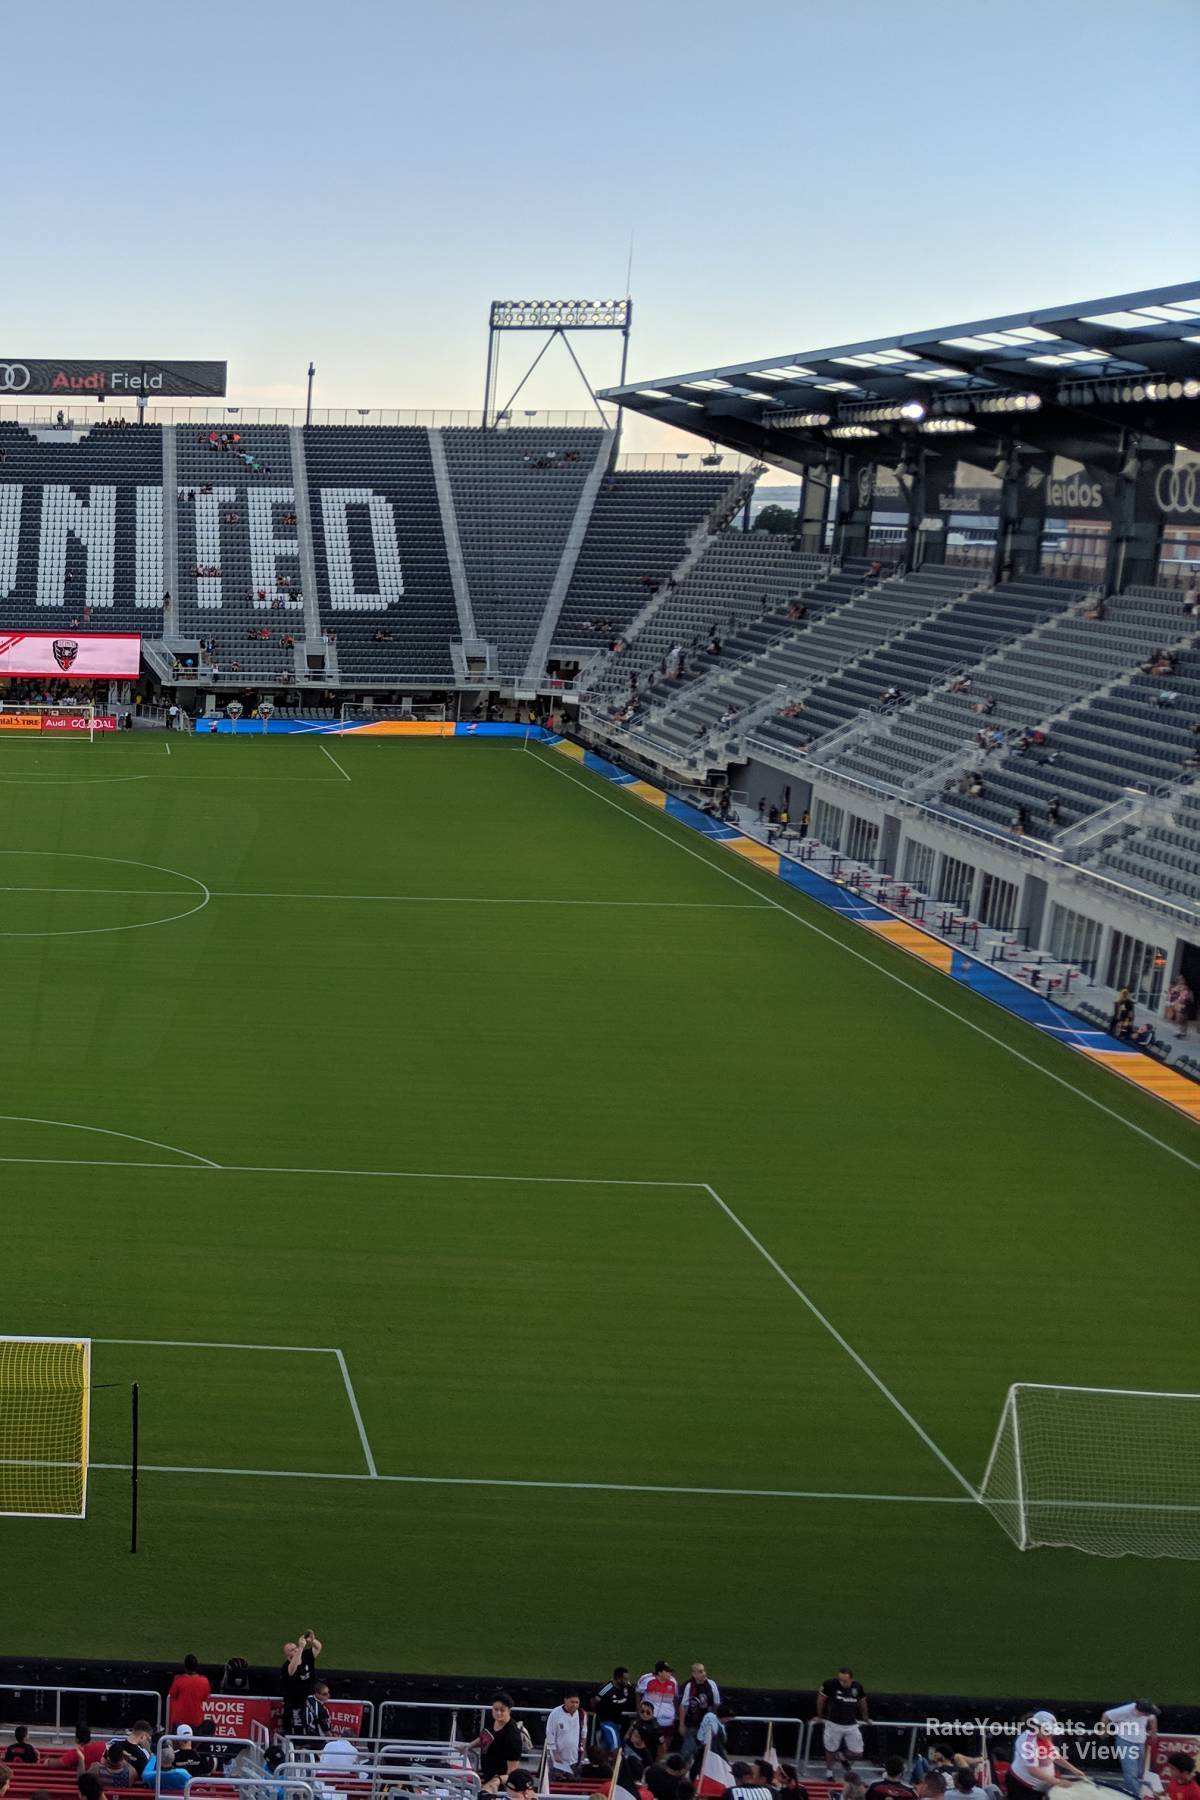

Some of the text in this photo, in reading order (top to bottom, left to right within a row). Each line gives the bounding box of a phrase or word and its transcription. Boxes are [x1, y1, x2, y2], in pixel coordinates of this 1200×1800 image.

[52, 373, 163, 390] Audi Field
[1046, 475, 1103, 508] leidos
[46, 719, 66, 727] Audi
[202, 1701, 245, 1713] MOKE
[203, 1713, 244, 1725] EVICE
[331, 1711, 359, 1724] LERT!
[209, 1744, 228, 1753] 137
